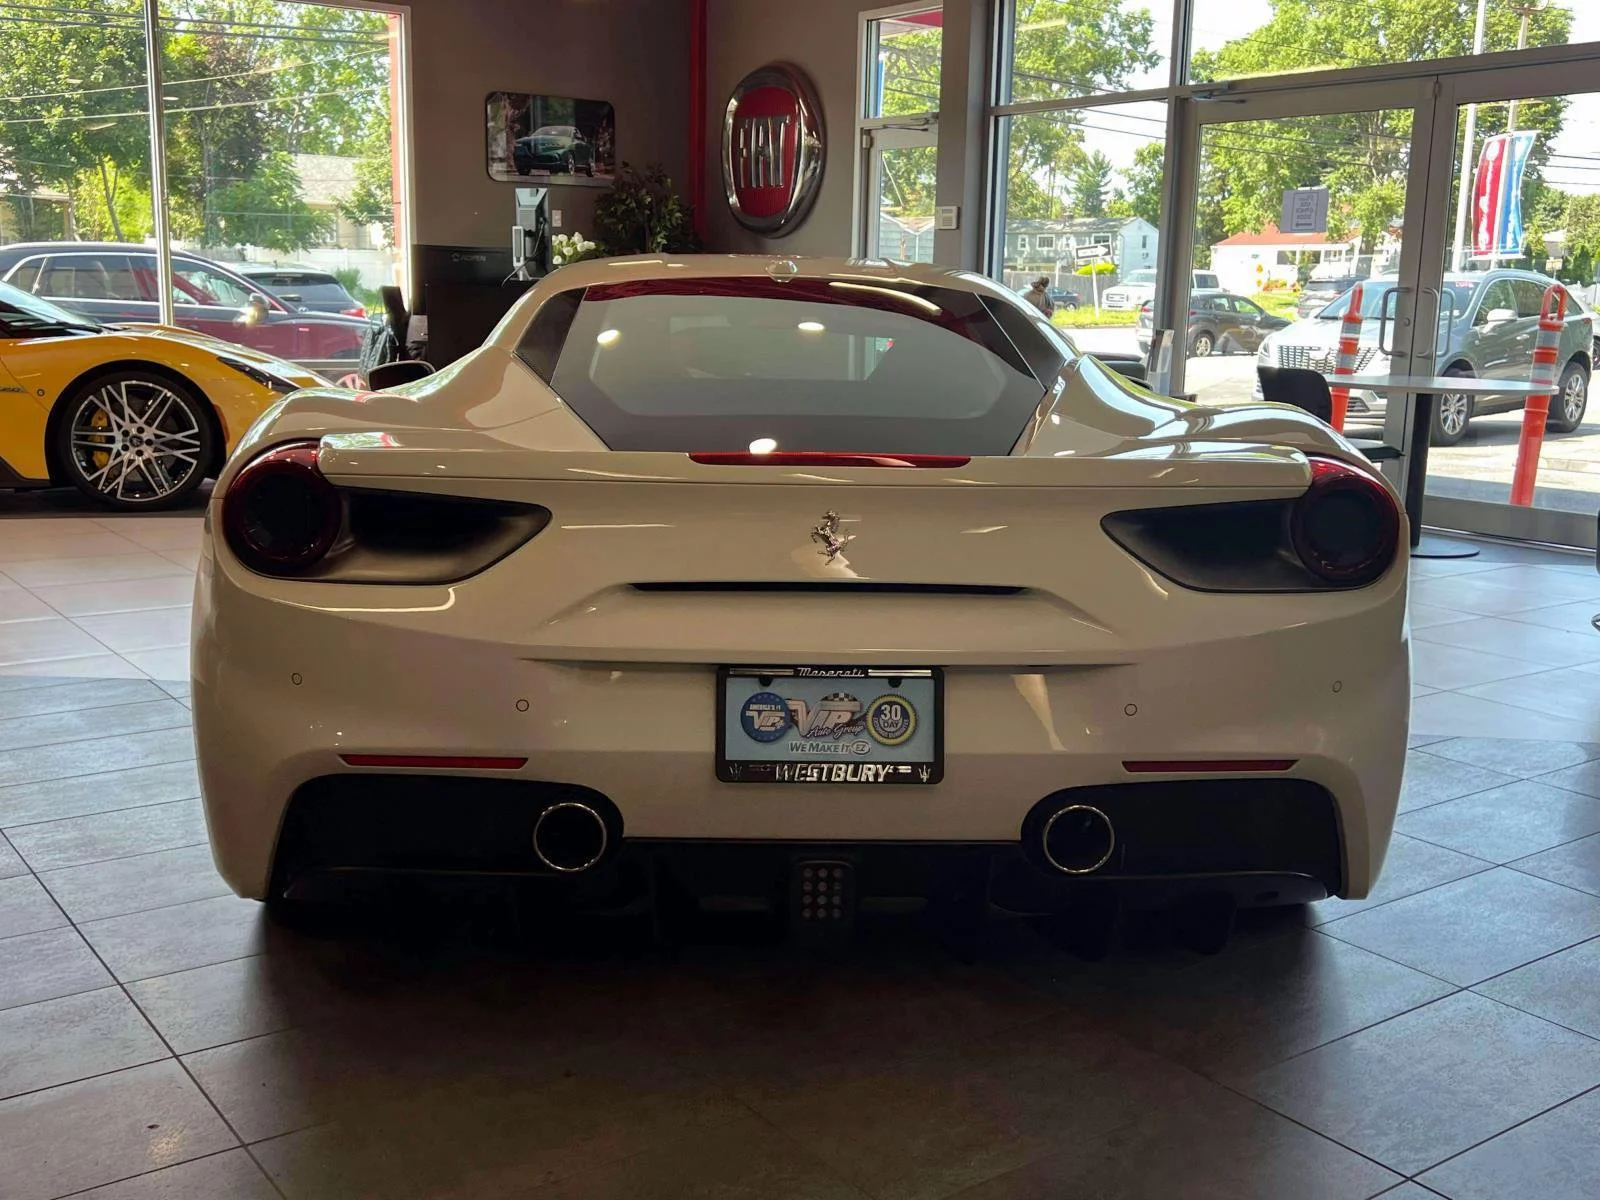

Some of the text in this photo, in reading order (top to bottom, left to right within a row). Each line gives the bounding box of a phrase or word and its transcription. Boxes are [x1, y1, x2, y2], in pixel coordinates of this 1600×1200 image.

[737, 115, 791, 189] FIAT
[797, 666, 865, 677] Maserati
[745, 710, 785, 729] VIP
[786, 699, 862, 736] VIP
[880, 704, 901, 720] 30
[806, 722, 866, 739] Auto Group
[883, 720, 899, 728] DAY
[808, 742, 840, 753] MAKE
[855, 744, 866, 752] EZ
[775, 763, 889, 782] WESTBURY
